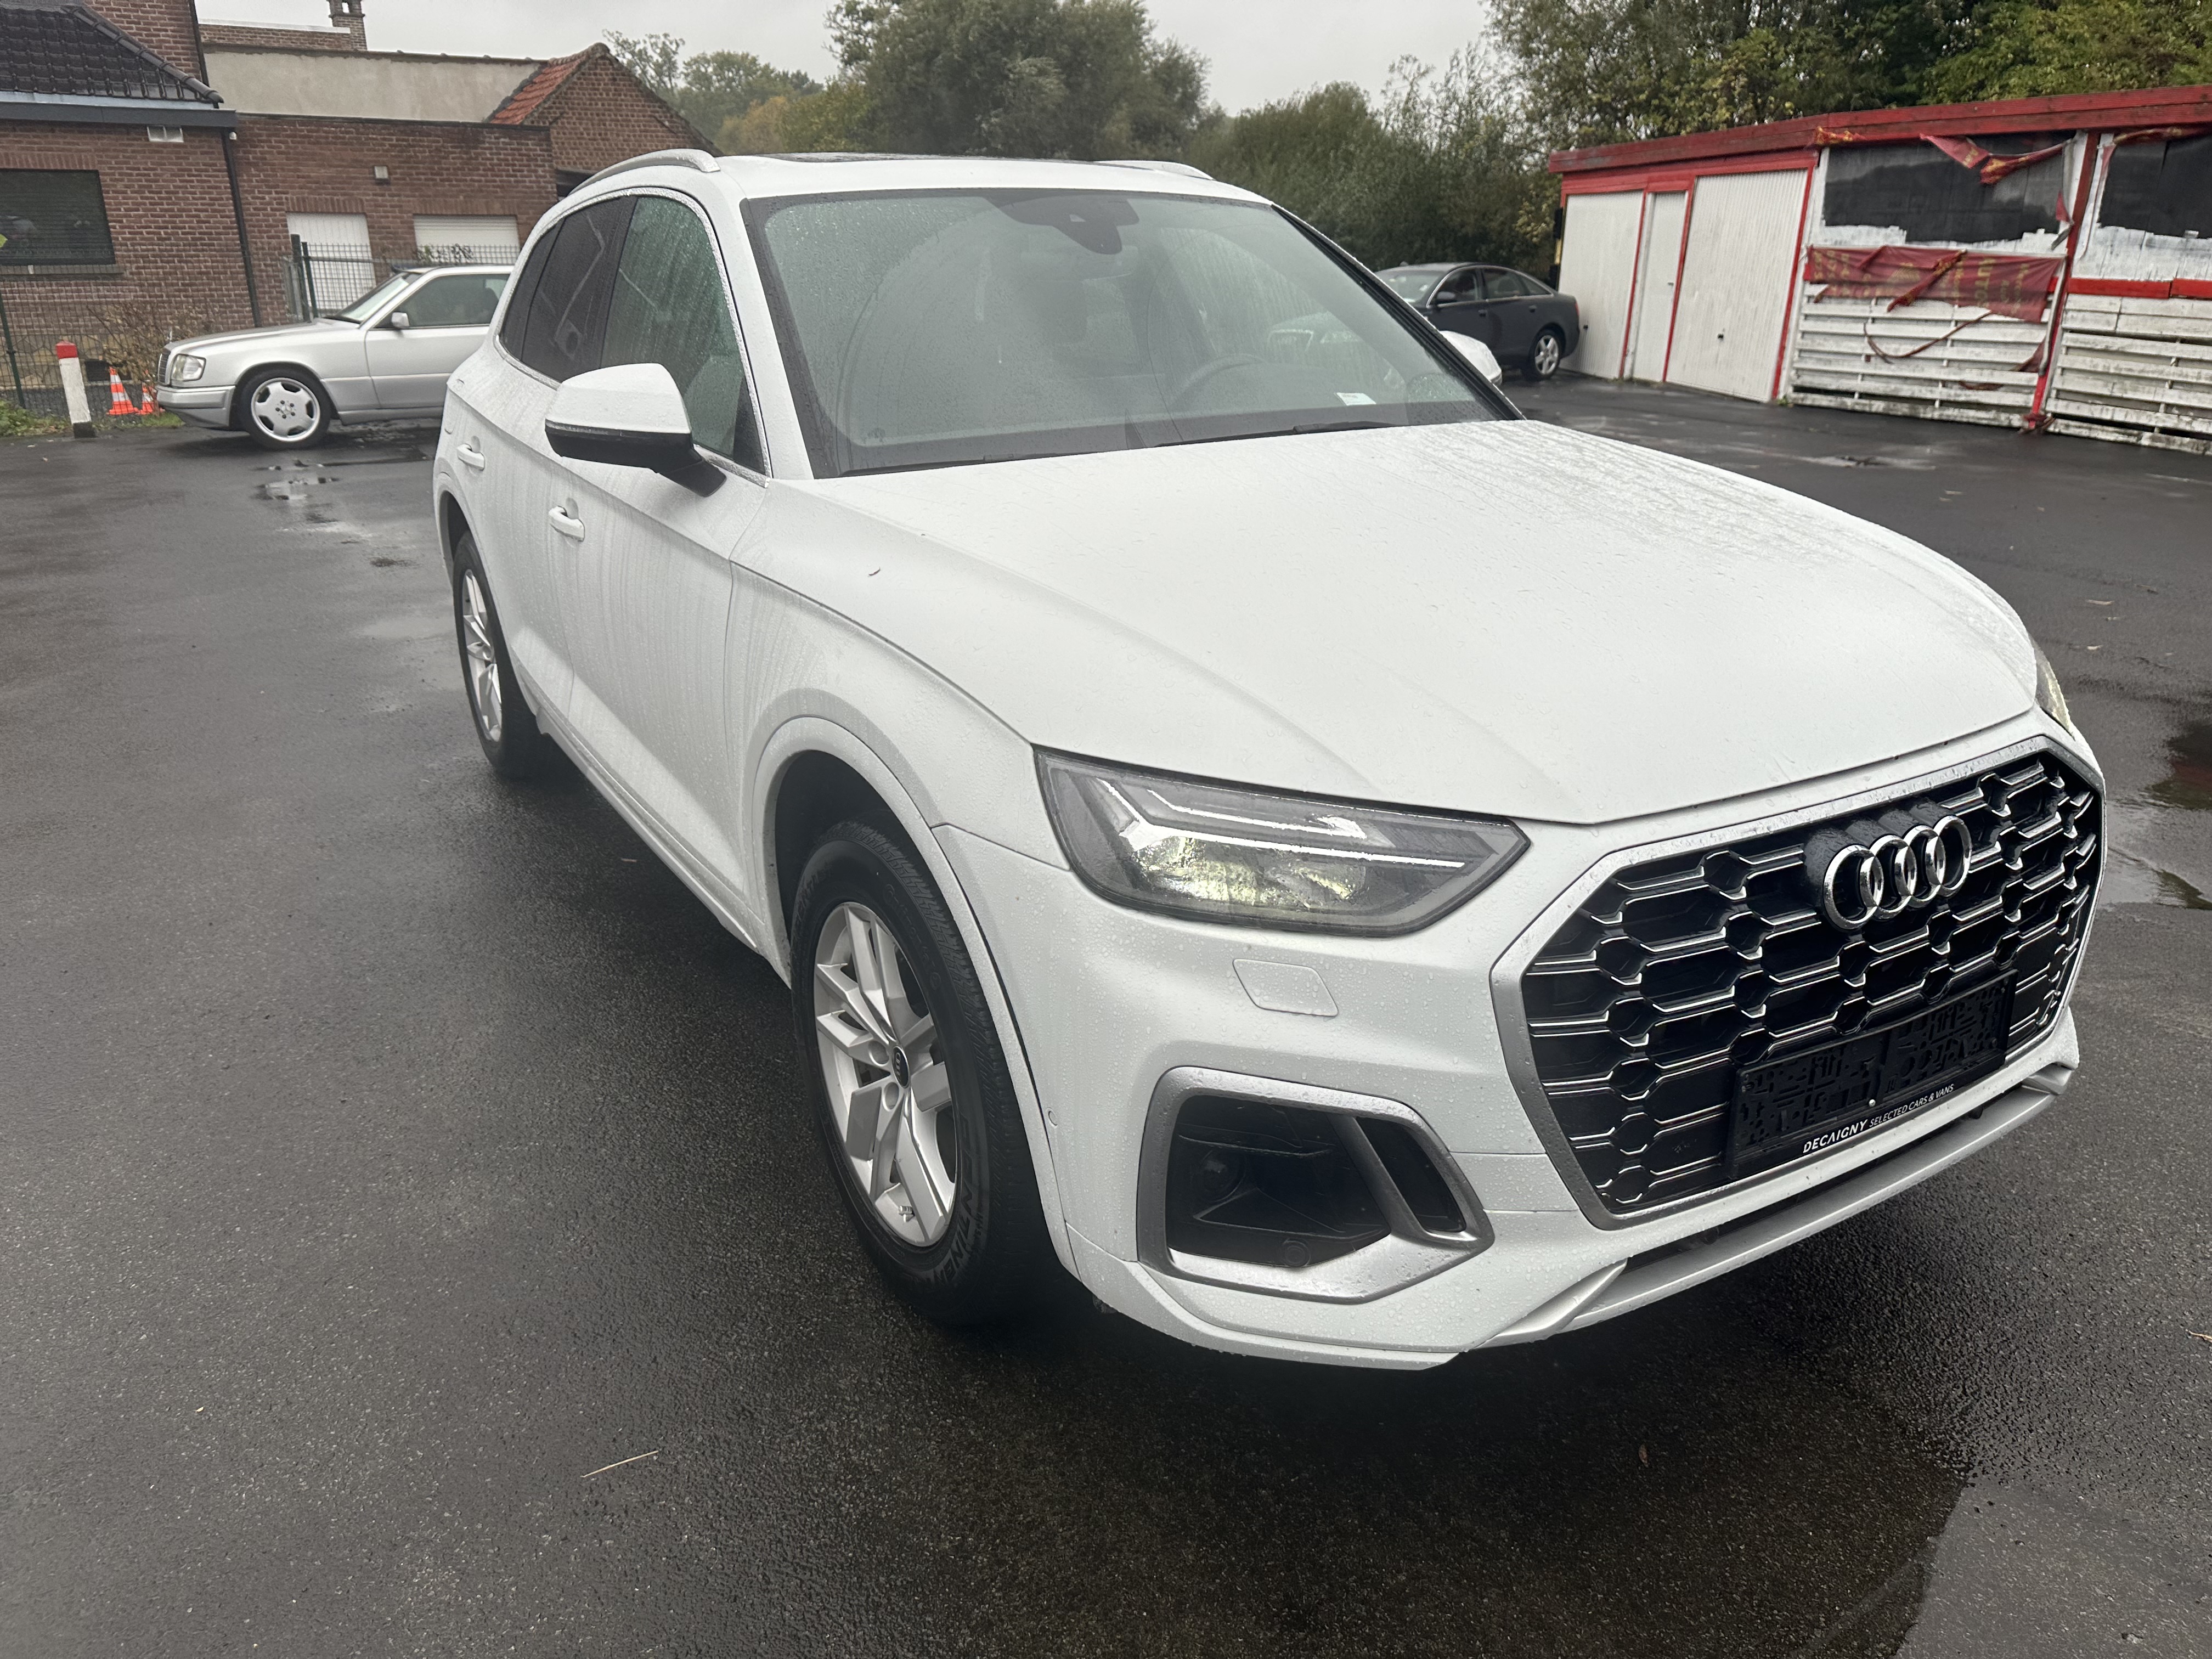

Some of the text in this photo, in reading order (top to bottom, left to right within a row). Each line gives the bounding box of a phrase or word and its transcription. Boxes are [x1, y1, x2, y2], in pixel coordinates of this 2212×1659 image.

[1803, 1084, 1954, 1153] DECAIGNY SELECTED CARS & VANS
